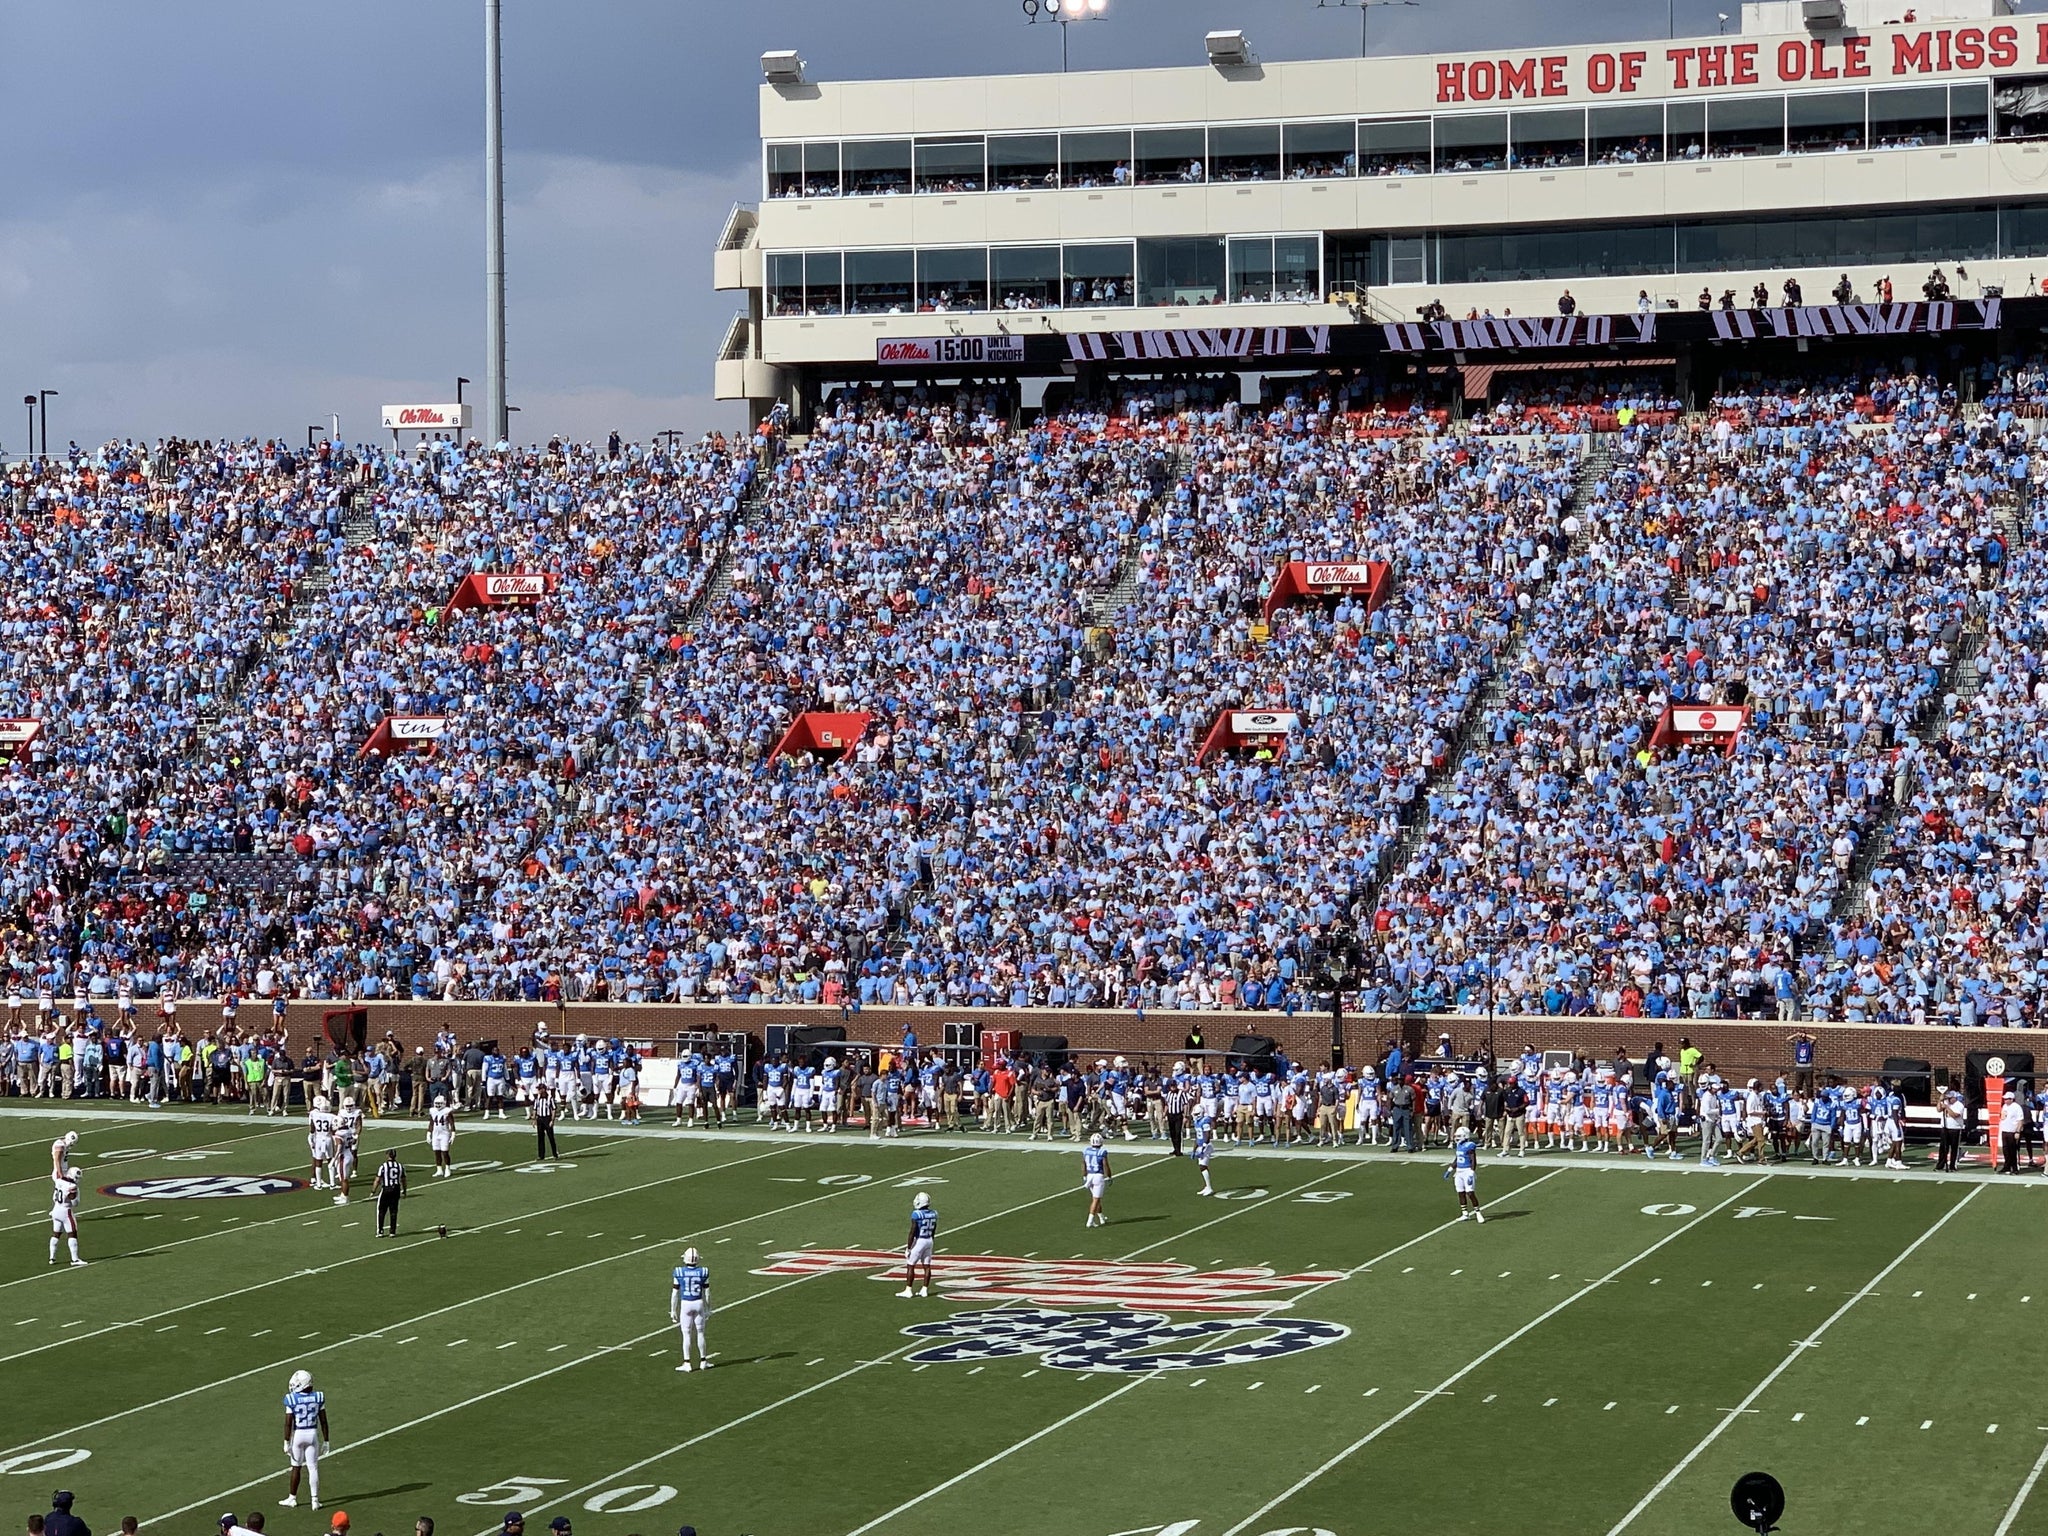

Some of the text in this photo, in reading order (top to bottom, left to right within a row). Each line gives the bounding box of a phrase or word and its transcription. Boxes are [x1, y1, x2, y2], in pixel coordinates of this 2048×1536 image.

[1436, 55, 1568, 103] HOME
[1587, 50, 1647, 95] OF
[1666, 43, 1759, 89] THE
[1777, 36, 1872, 82] OLE
[1892, 26, 2019, 75] MISS
[934, 338, 983, 361] 15:00
[987, 336, 1011, 348] UNTIL
[880, 342, 930, 361] Ole Miss
[987, 349, 1023, 361] KICKOFF
[384, 418, 392, 426] A
[399, 408, 445, 424] Ole Miss
[452, 417, 459, 425] B
[1313, 567, 1361, 582] Ole Miss
[493, 578, 538, 593] Ole Miss
[1256, 715, 1273, 724] Ford
[316, 1119, 330, 1133] 33
[434, 1115, 445, 1126] 44
[1085, 1155, 1100, 1171] 14
[389, 1167, 398, 1179] C
[920, 1219, 936, 1236] 25
[683, 1276, 702, 1297] 16
[294, 1402, 319, 1427] 22
[455, 1476, 679, 1514] 50
